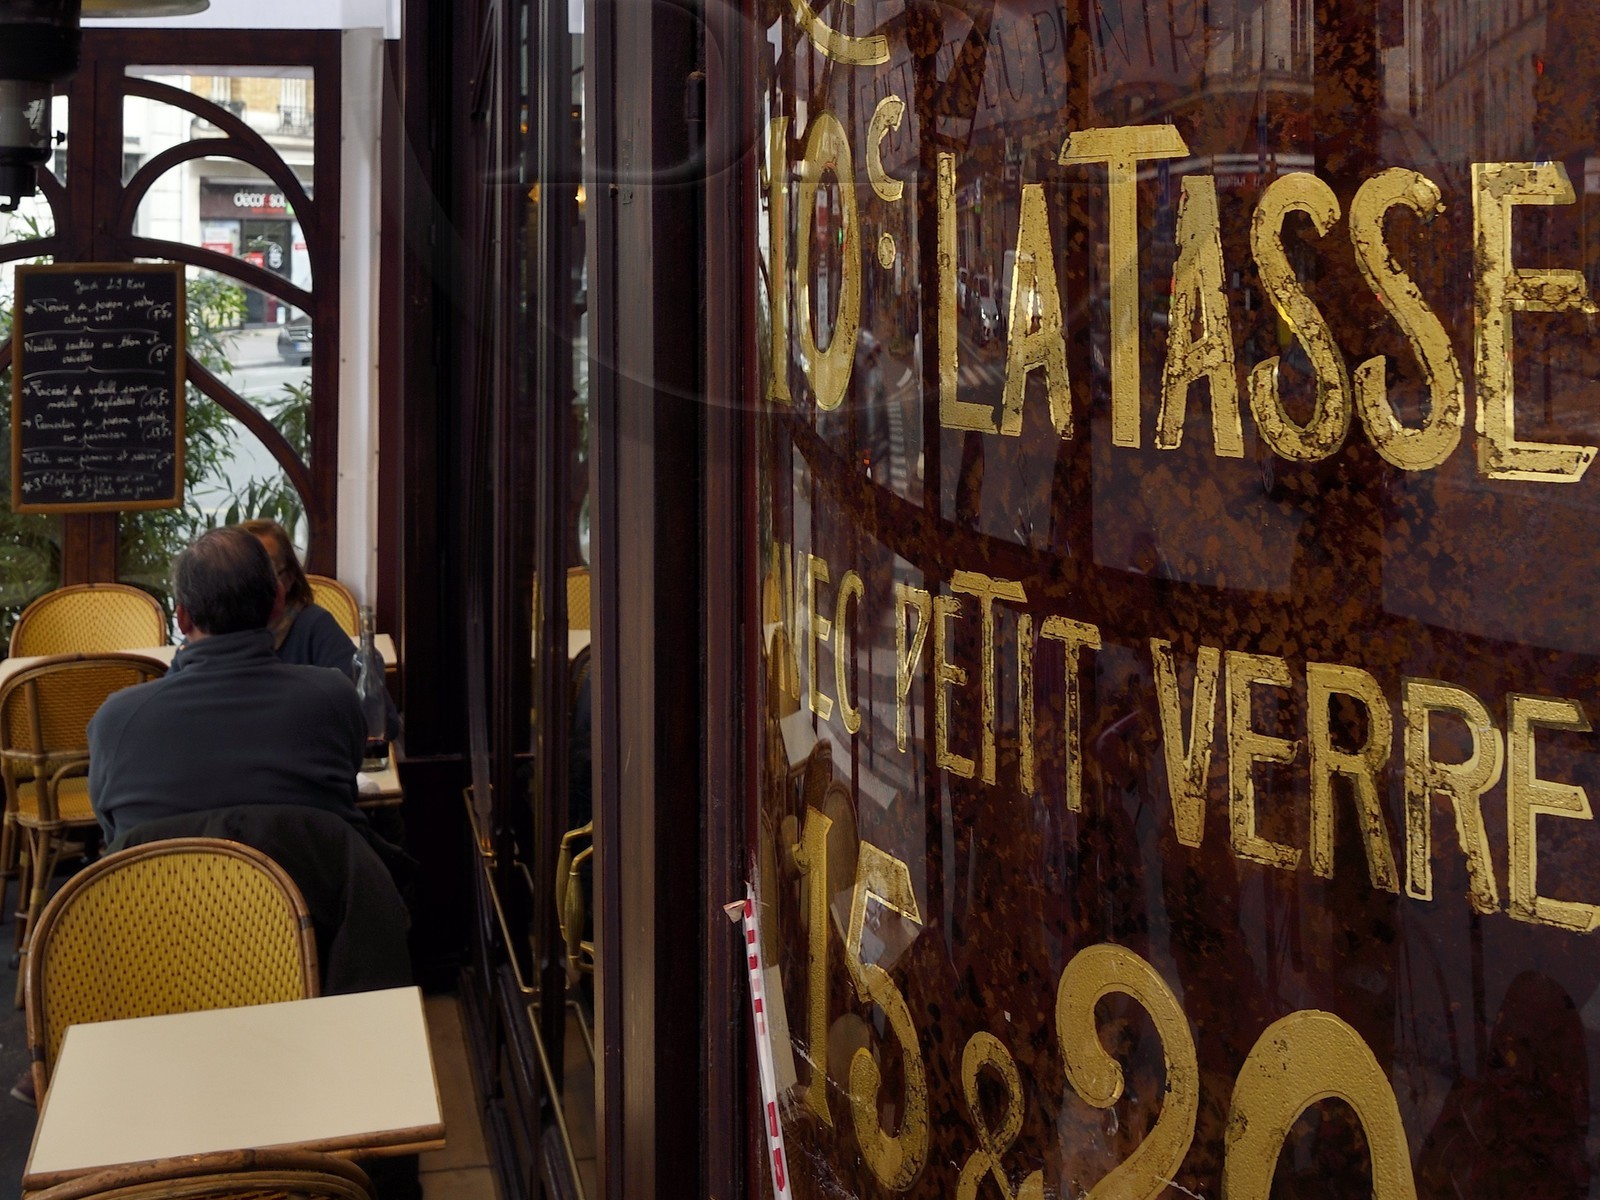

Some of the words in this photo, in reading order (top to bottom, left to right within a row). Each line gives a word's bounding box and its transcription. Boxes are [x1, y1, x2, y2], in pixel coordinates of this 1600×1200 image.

[895, 570, 1102, 812] PETIT
[1150, 639, 1599, 935] VERRE
[794, 806, 931, 1193] 15
